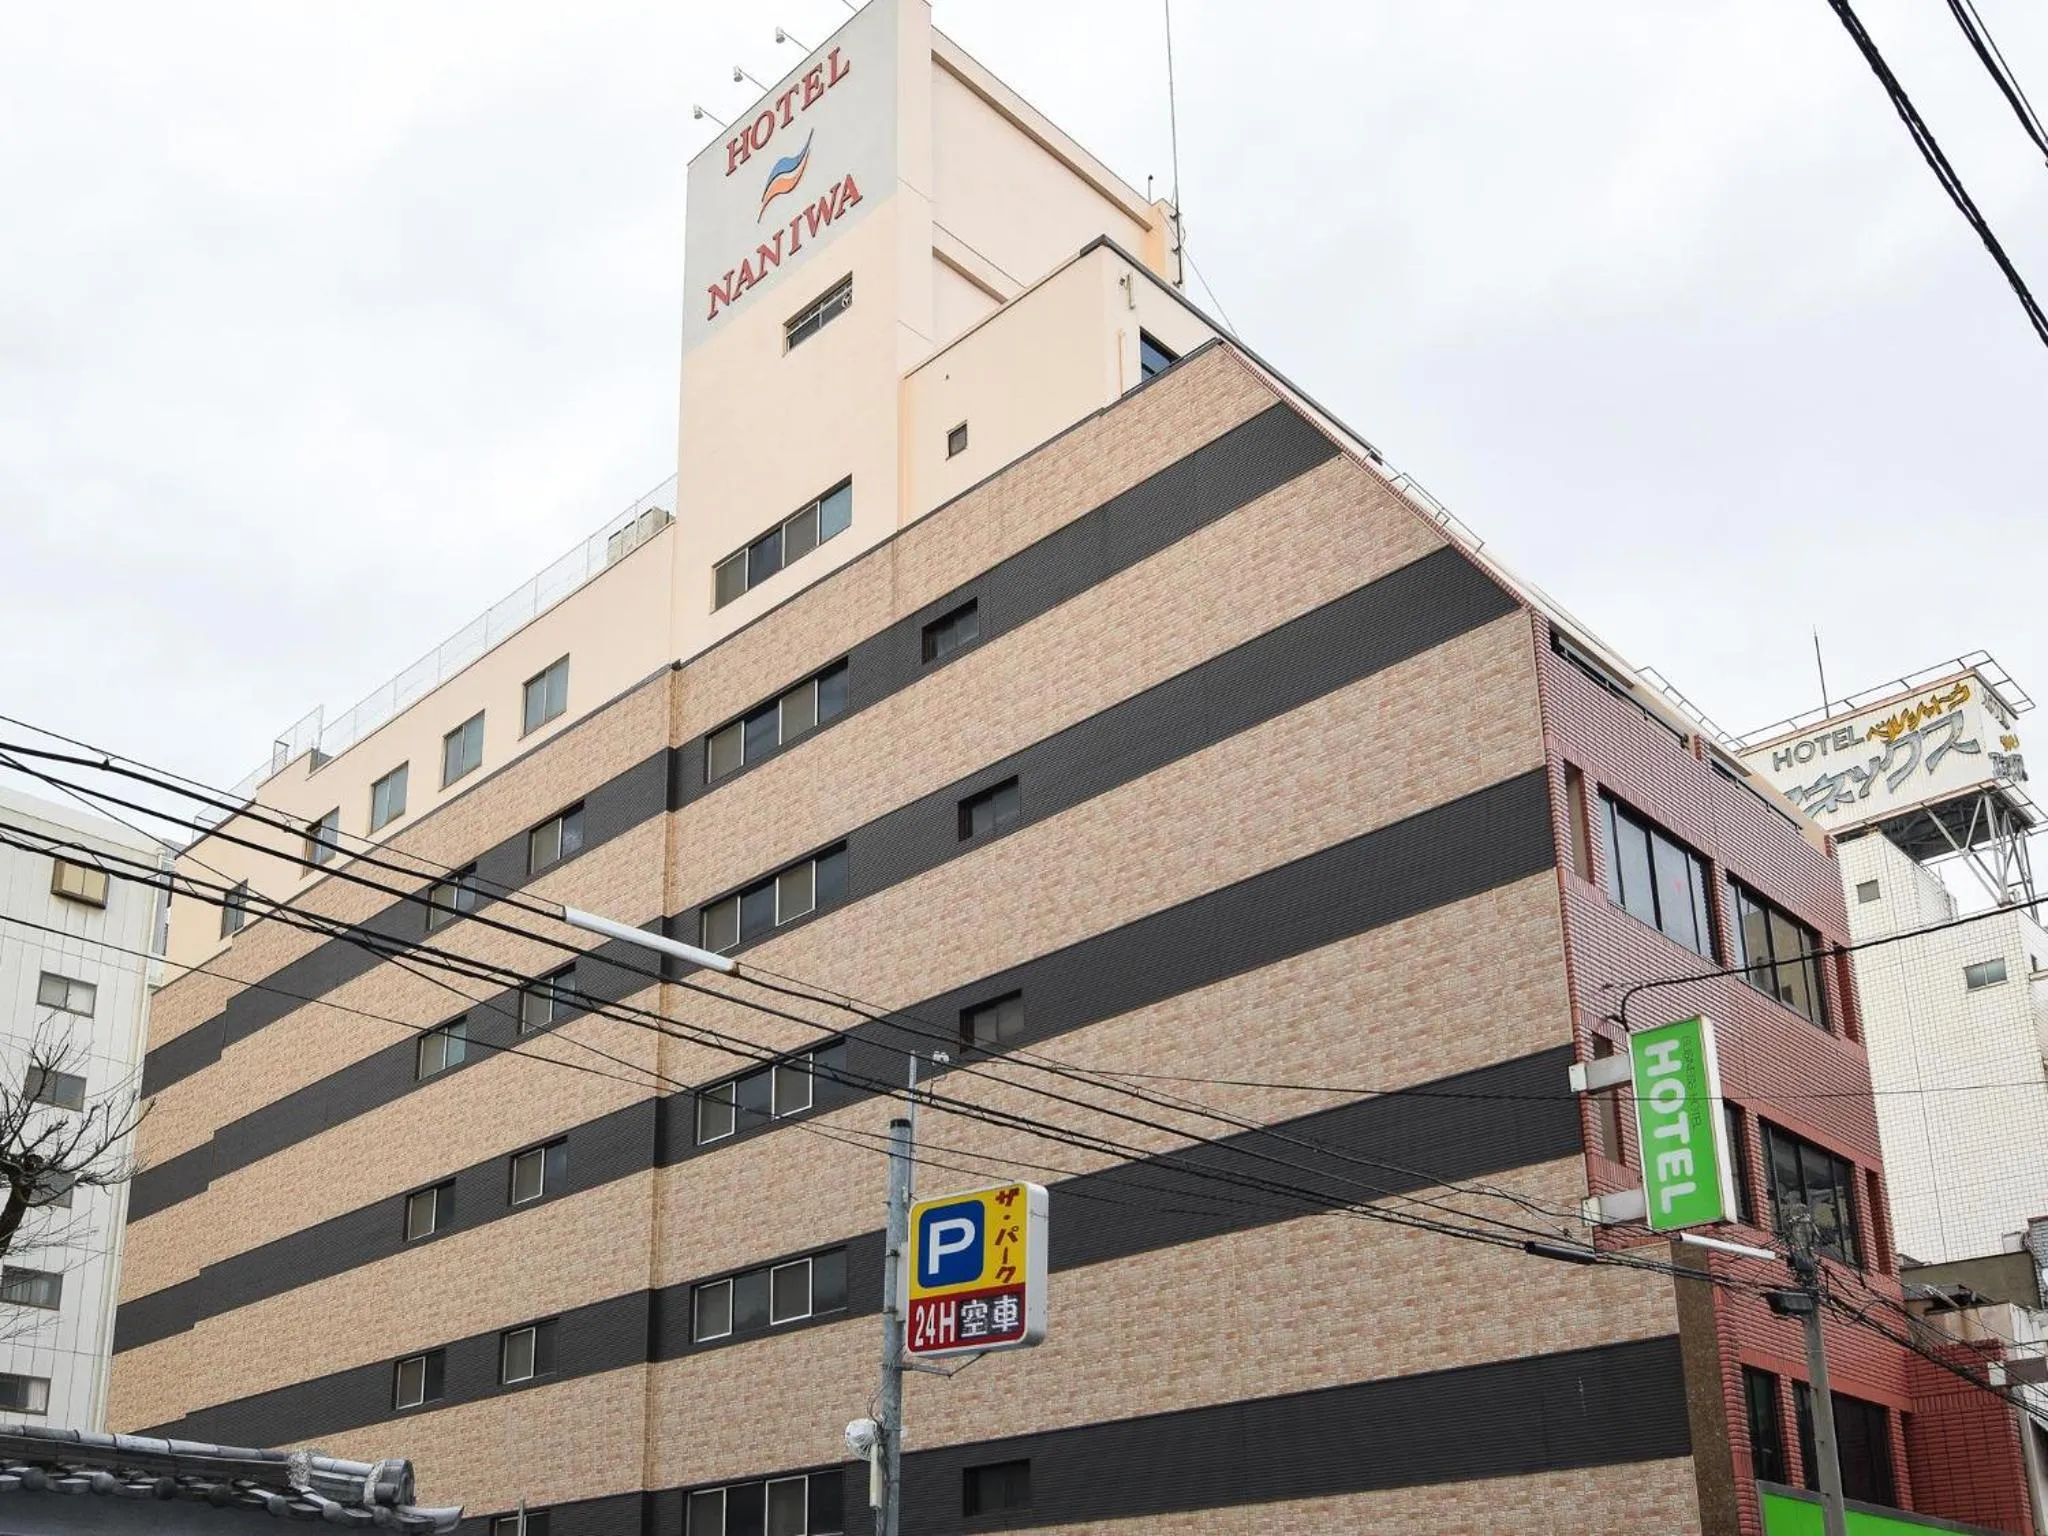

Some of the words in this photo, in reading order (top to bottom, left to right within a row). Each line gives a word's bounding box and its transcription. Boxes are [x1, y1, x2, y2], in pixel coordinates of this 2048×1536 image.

[725, 46, 850, 177] HOTEL
[707, 173, 863, 321] NANIWA
[1772, 725, 1866, 772] HOTEL
[1644, 1039, 1697, 1215] HOTEL
[928, 1217, 976, 1275] P
[995, 1187, 1020, 1284] ザ・パーク
[914, 1301, 956, 1347] 24H
[960, 1294, 1020, 1338] 空車
